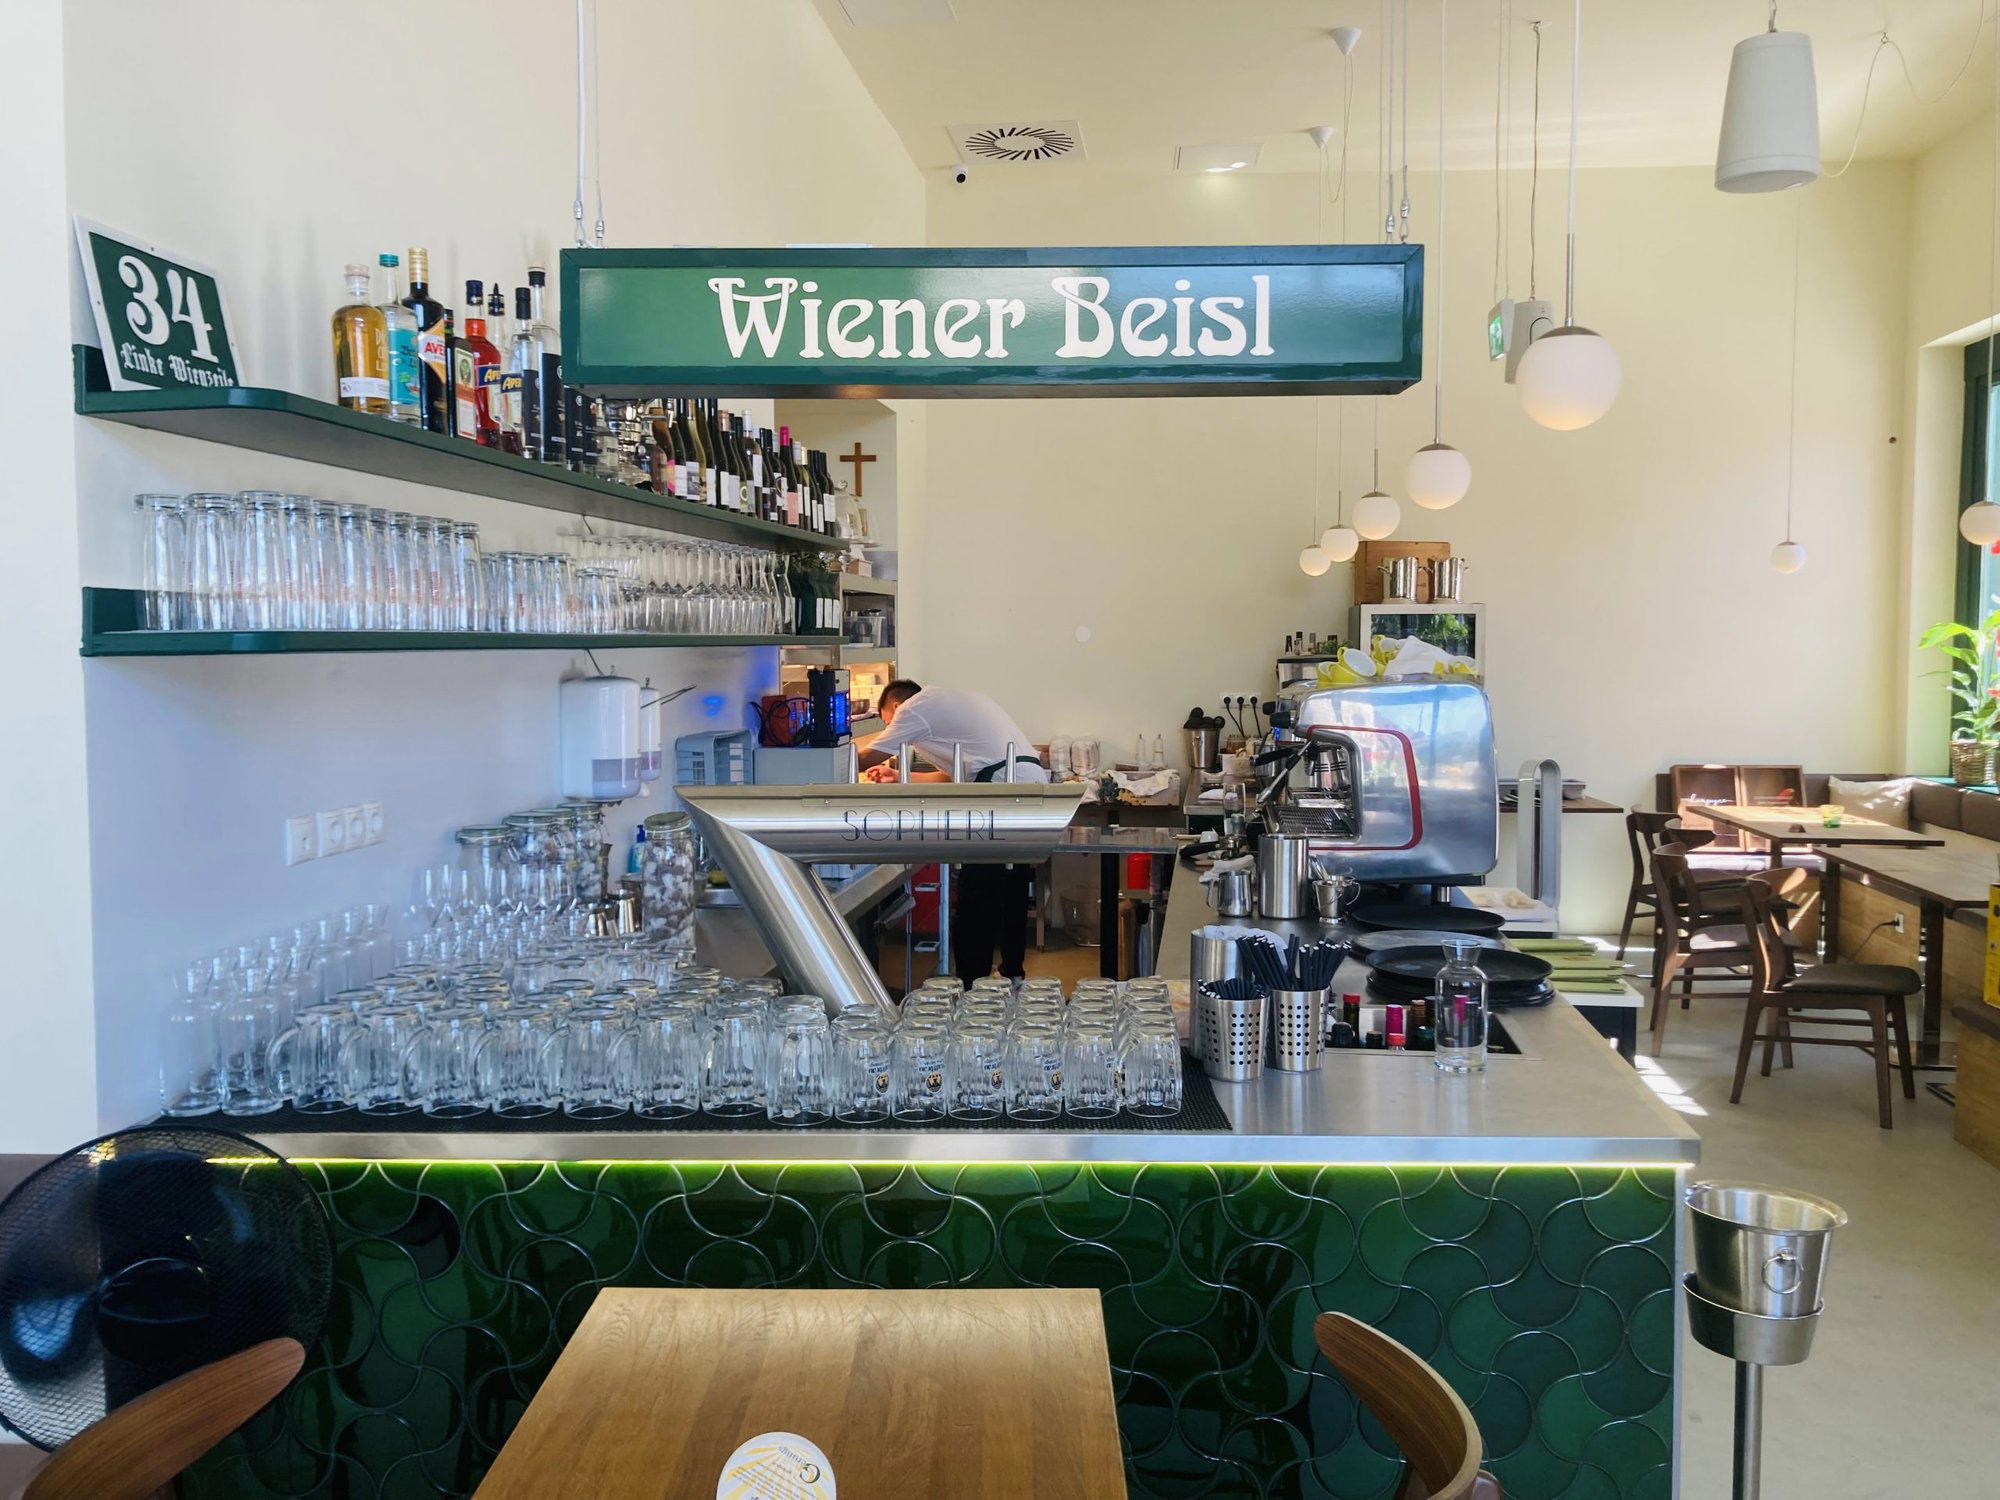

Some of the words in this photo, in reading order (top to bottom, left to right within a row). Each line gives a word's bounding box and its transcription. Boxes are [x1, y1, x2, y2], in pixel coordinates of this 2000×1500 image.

[118, 255, 219, 364] 34
[708, 277, 1026, 359] Wiener
[1052, 275, 1275, 359] Beisl
[120, 342, 164, 376] Linke
[841, 810, 1006, 842] SOPHERL
